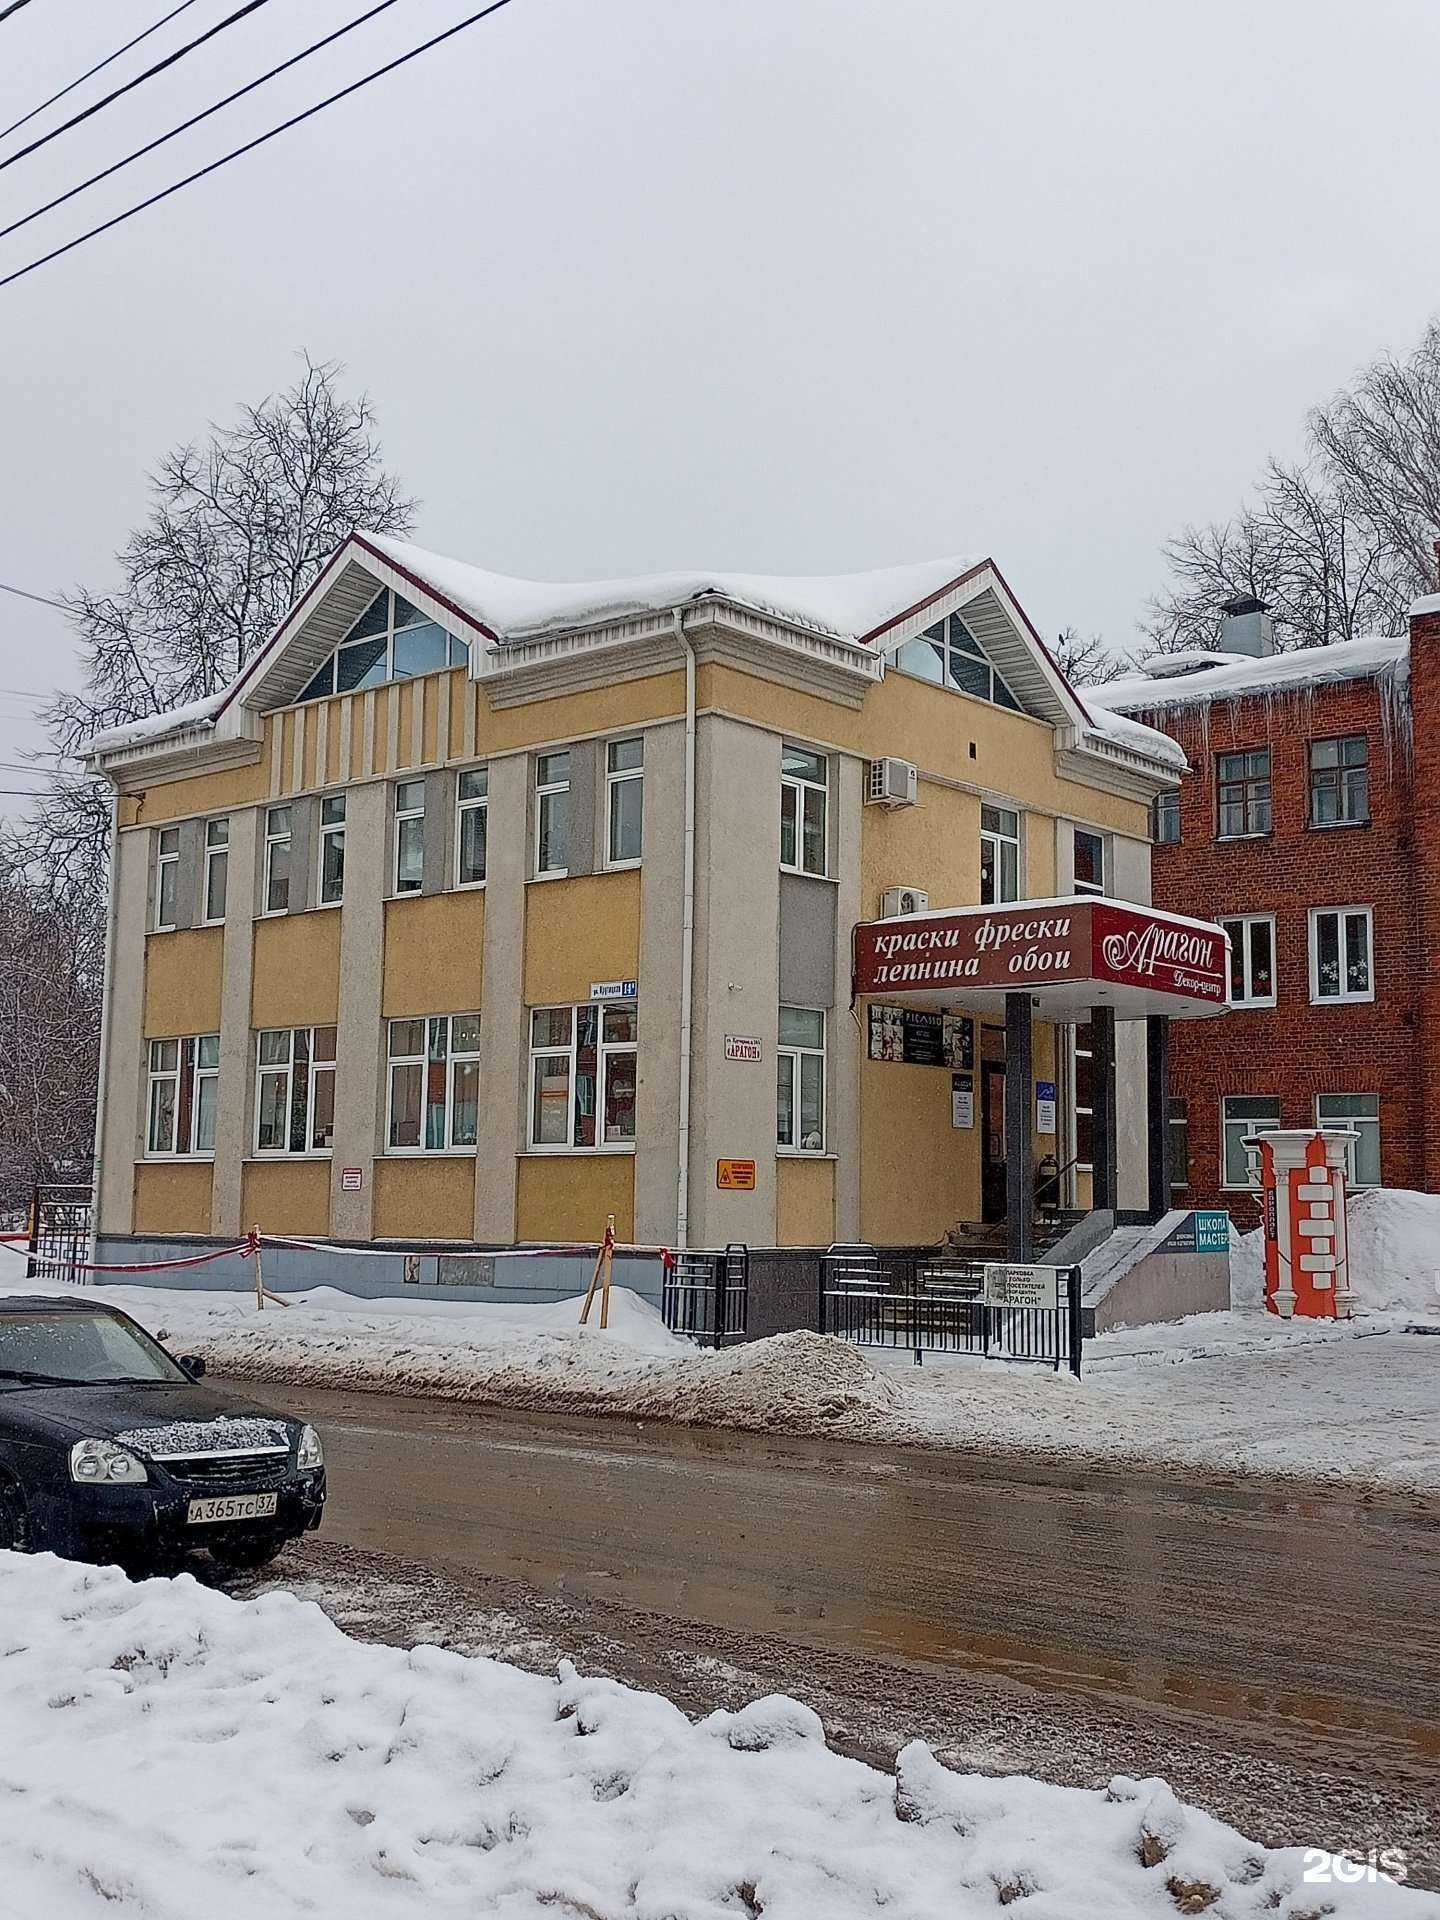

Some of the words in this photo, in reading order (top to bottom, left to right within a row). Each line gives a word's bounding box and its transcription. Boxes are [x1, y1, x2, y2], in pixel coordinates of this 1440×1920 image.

[875, 928, 960, 959] краски
[974, 917, 1071, 952] фрески
[1102, 922, 1213, 976] Арагон
[873, 956, 980, 984] лепнина
[1008, 945, 1071, 973] обои
[1198, 1218, 1227, 1231] ШКОЛА
[258, 1495, 273, 1509] 37
